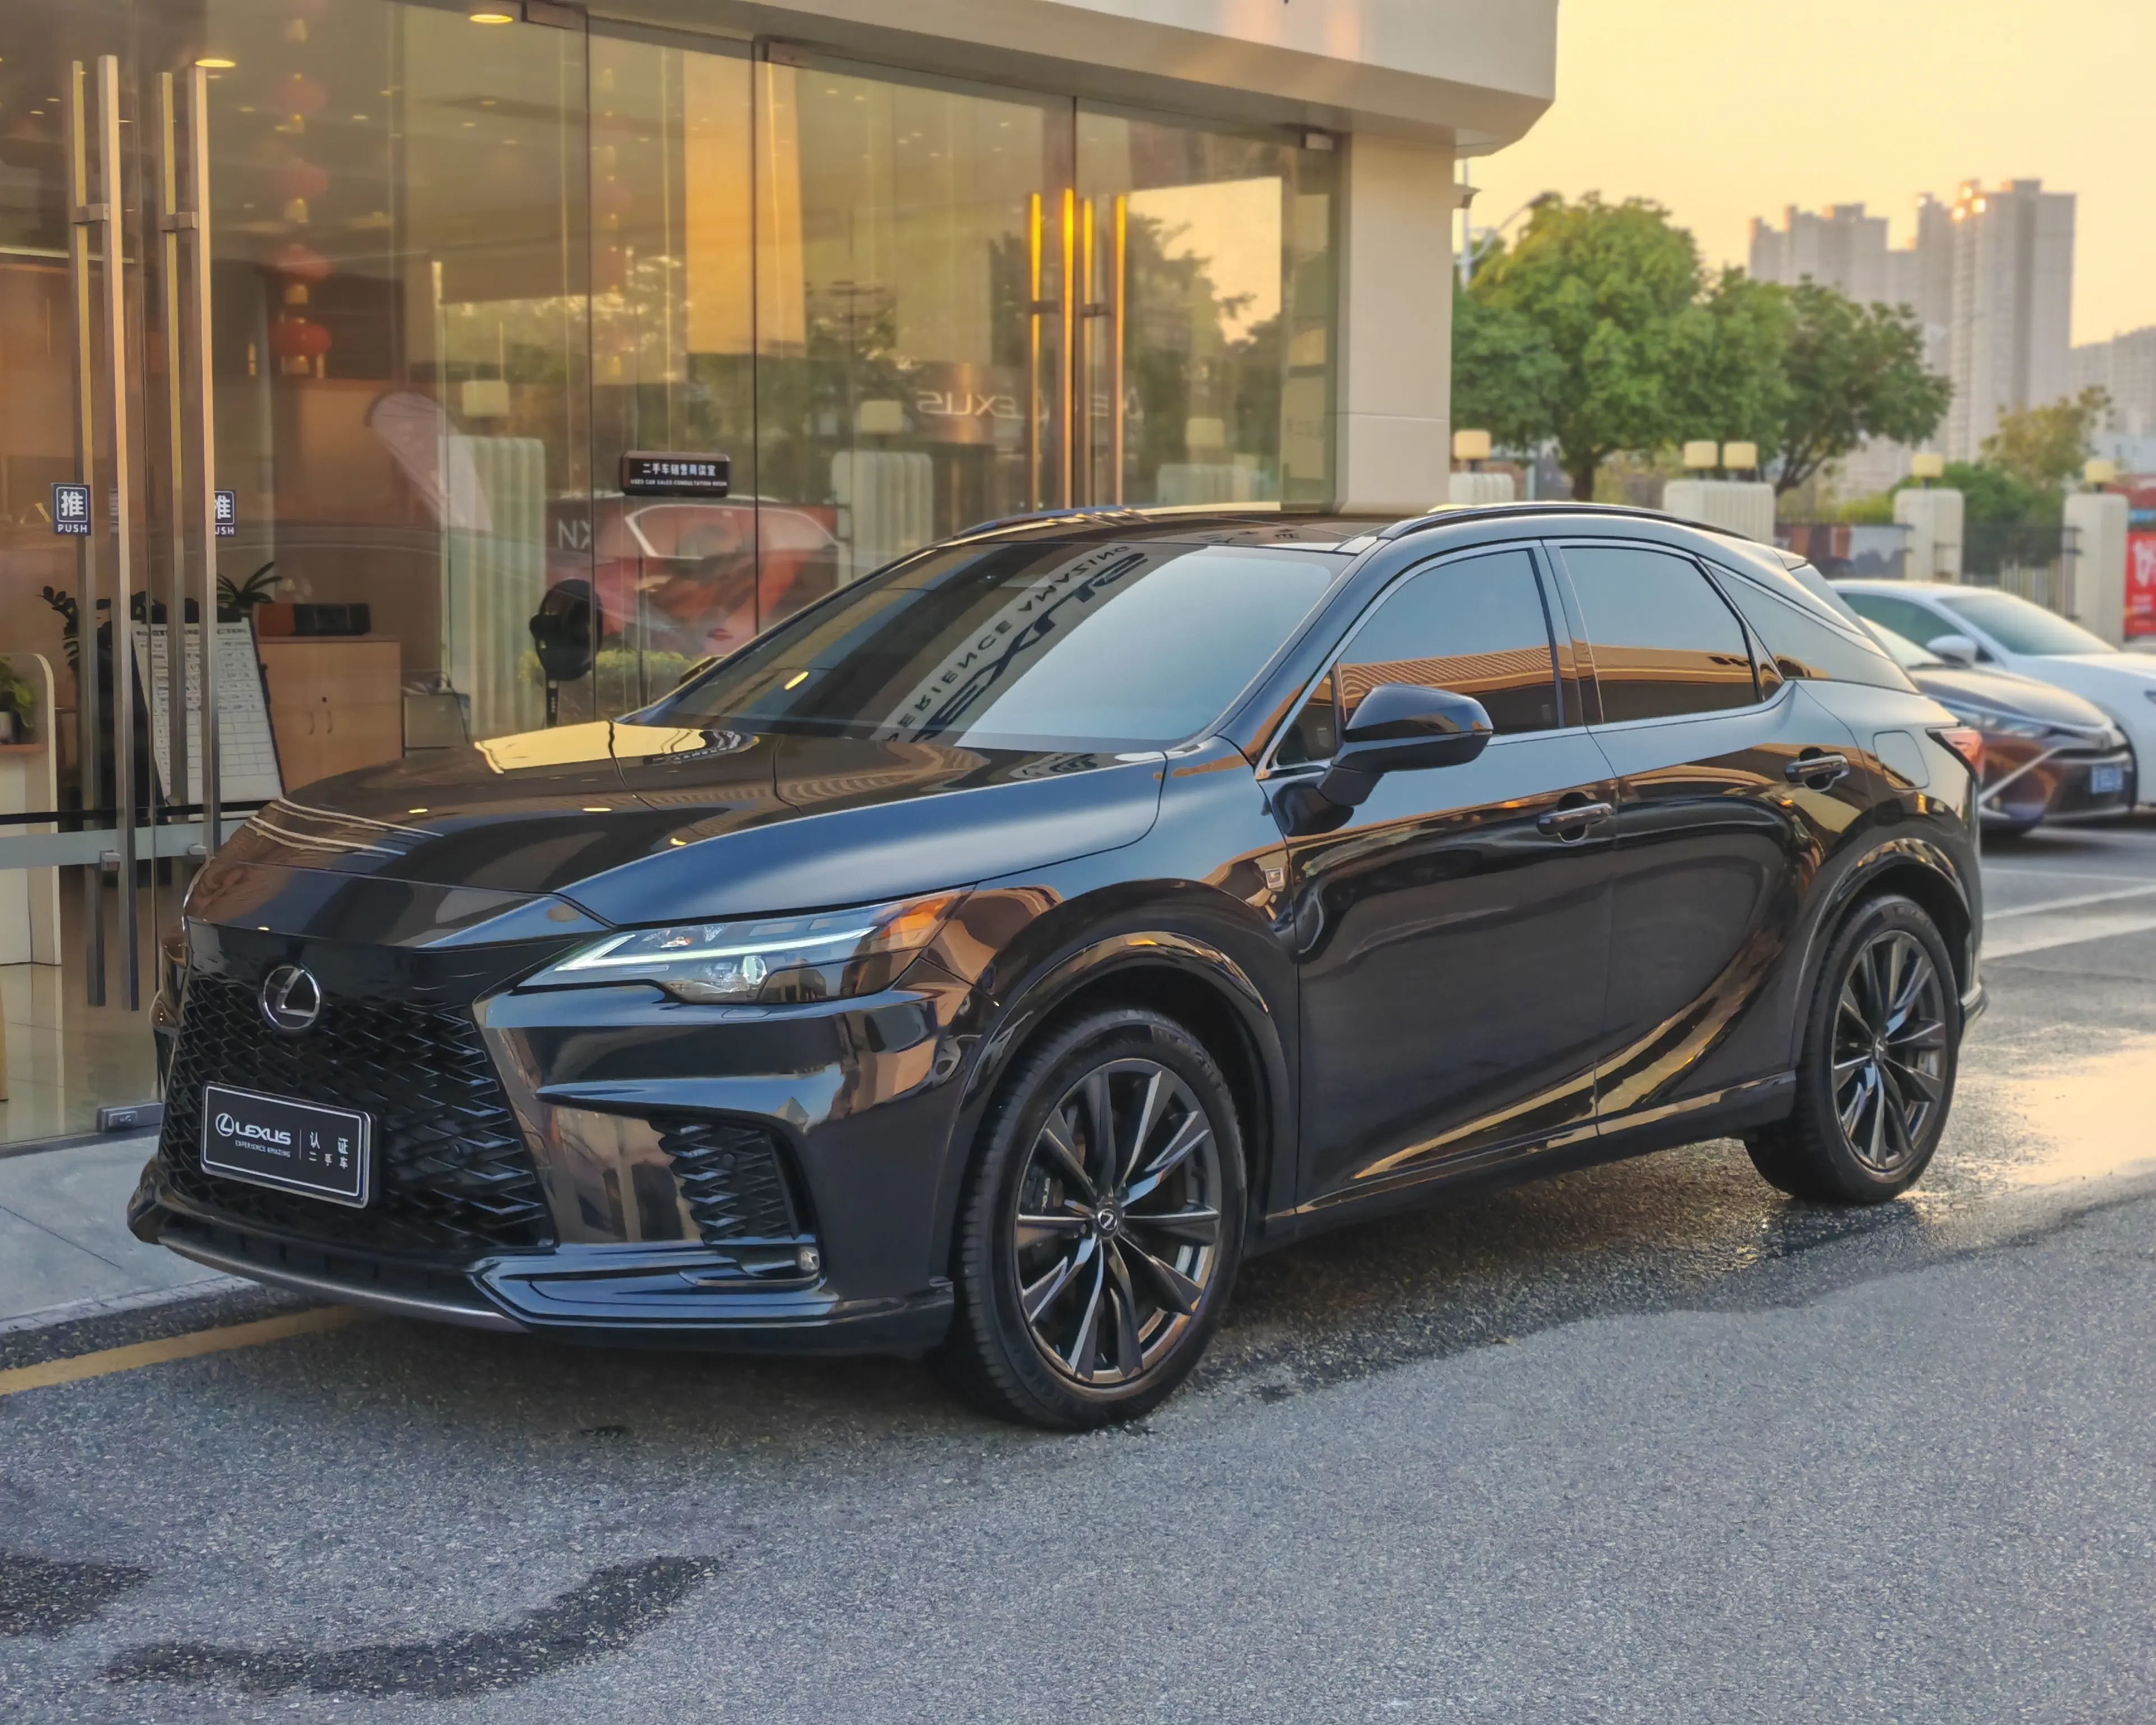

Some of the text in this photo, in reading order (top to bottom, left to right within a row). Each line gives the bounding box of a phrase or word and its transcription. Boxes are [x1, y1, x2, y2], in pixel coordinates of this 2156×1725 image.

[61, 491, 84, 517] 推
[57, 524, 88, 533] PUSH
[215, 527, 235, 535] USH
[235, 1121, 291, 1146] LEXUS
